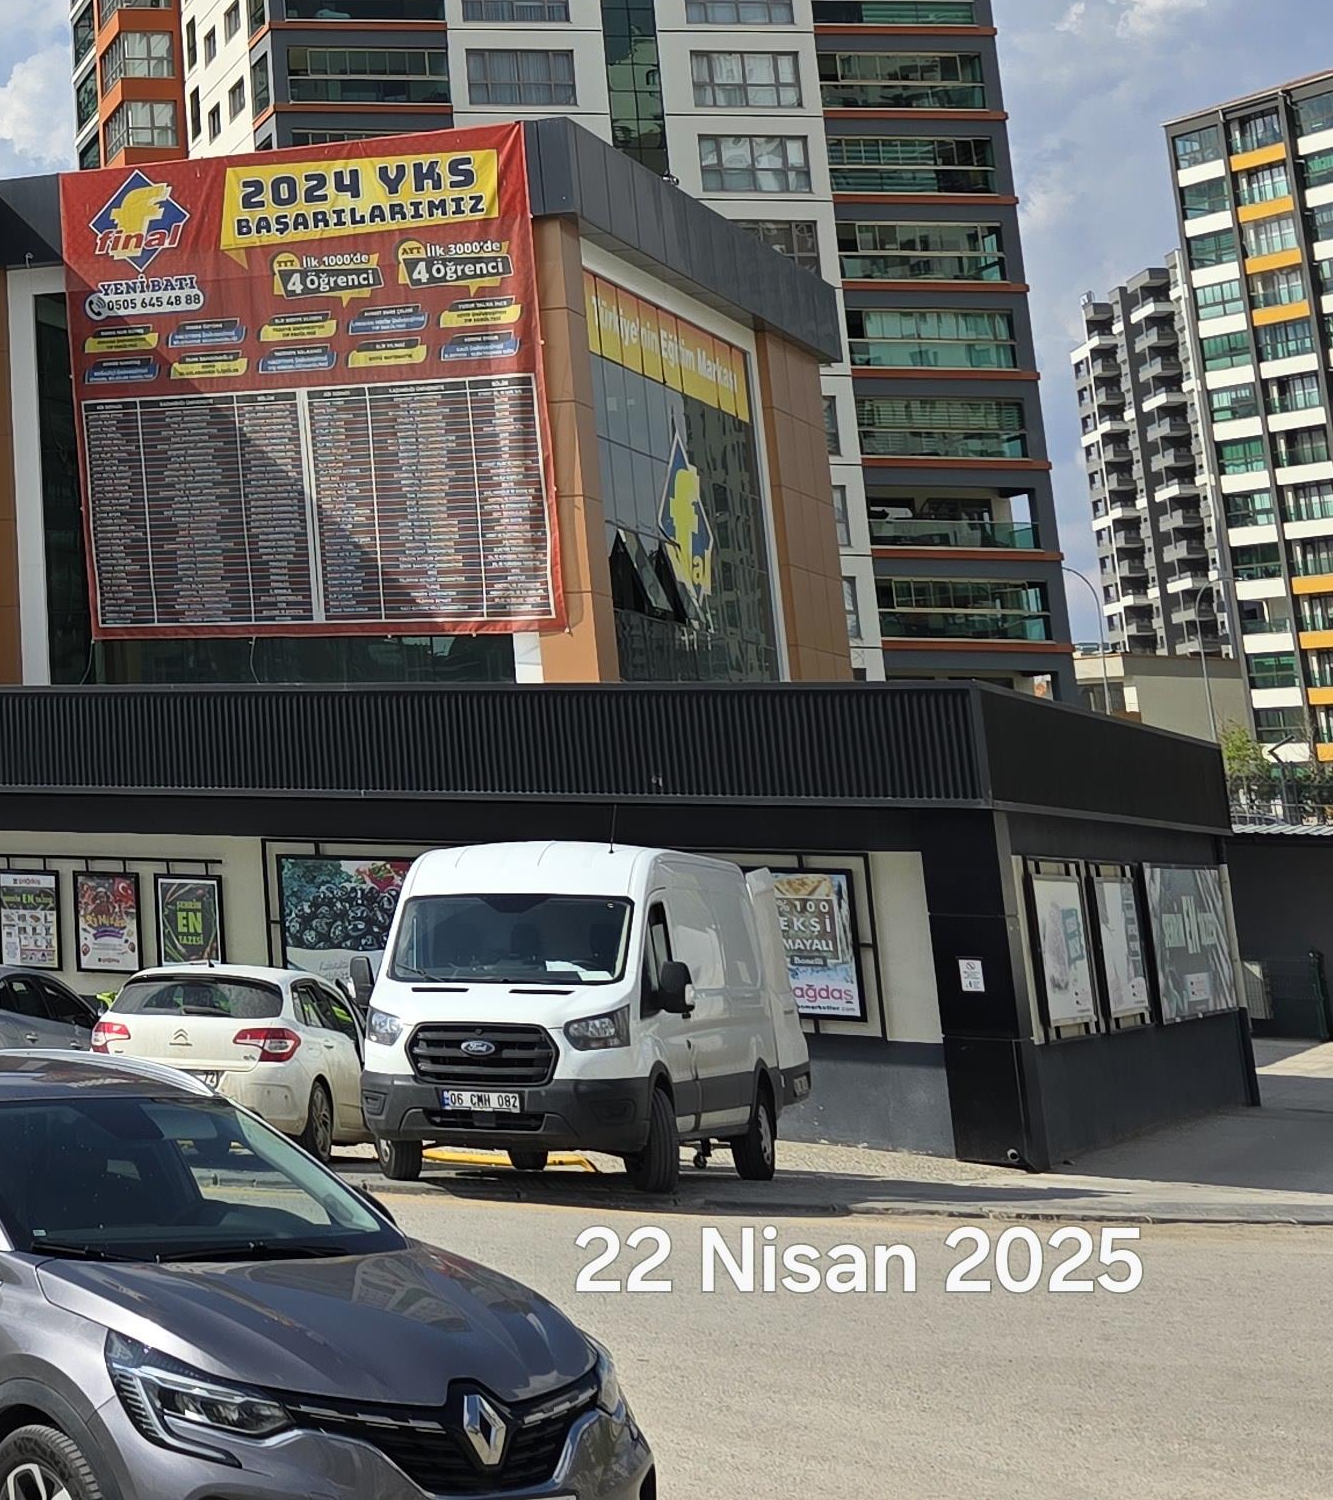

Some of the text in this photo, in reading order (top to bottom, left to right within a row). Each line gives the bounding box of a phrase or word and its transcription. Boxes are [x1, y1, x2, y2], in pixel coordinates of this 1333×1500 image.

[240, 155, 478, 211] 2024 YKS
[235, 194, 486, 238] BAŞARILARIMIZ
[95, 223, 183, 255] final
[447, 240, 501, 255] 3000'de
[322, 252, 369, 267] 1000'de
[412, 258, 503, 282] 4 Öğrenci
[99, 274, 148, 297] YENİ
[287, 269, 374, 294] 4 Öğrenci
[107, 293, 201, 312] 0505 645 48 88
[177, 911, 203, 934] EN
[779, 915, 831, 935] EKŞİ
[792, 984, 854, 1004] ağdaş
[449, 1092, 464, 1106] 06
[497, 1094, 518, 1108] 082
